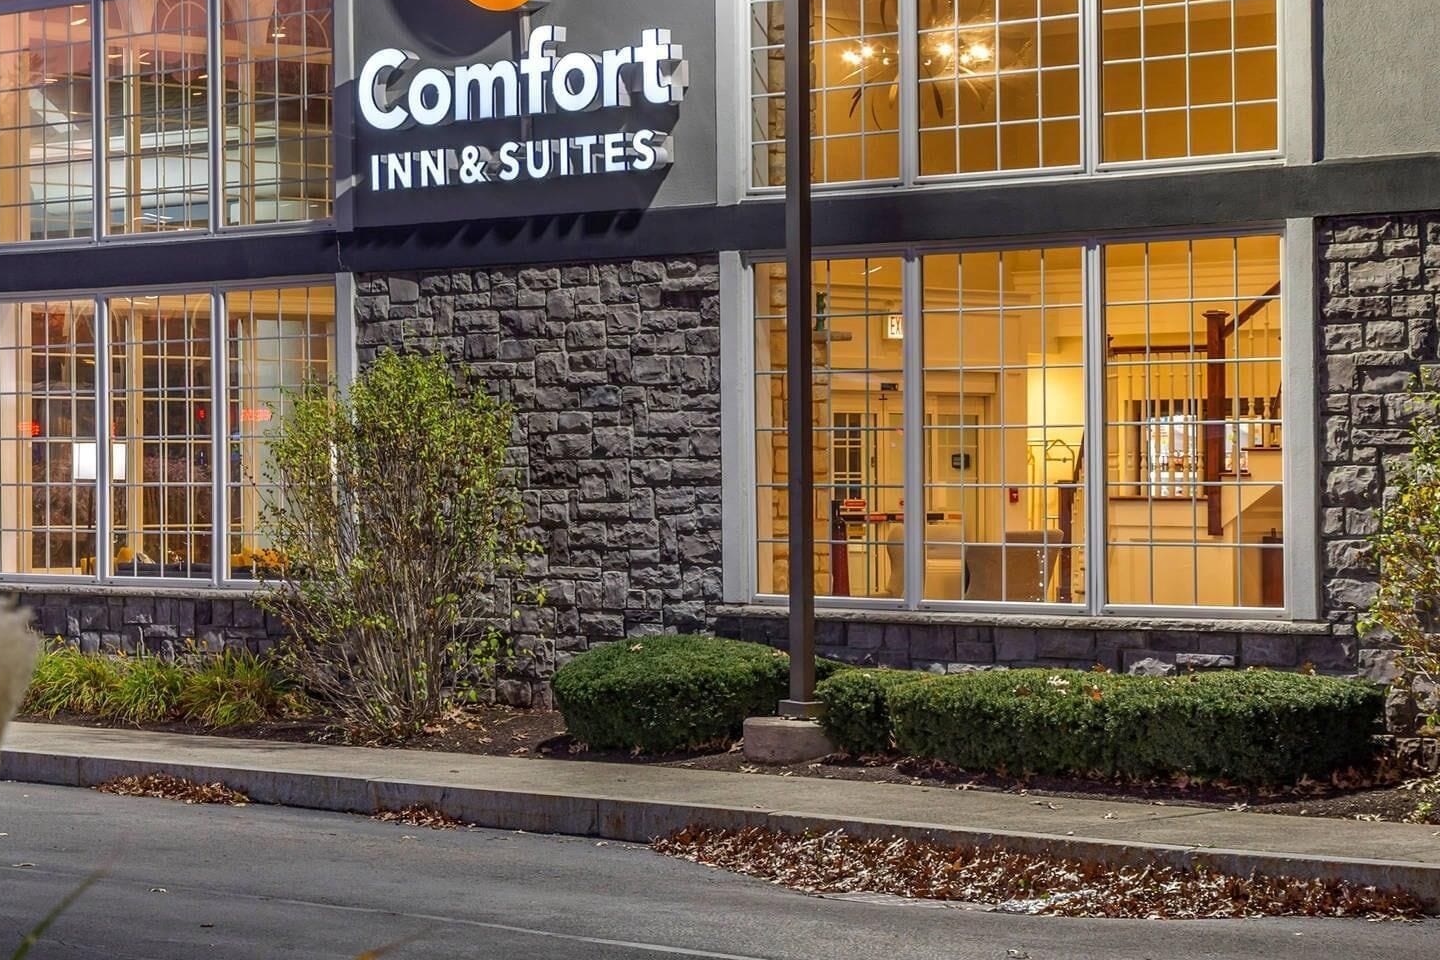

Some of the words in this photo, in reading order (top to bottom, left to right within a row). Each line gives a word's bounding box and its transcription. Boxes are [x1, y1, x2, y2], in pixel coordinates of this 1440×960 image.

[359, 24, 673, 130] Comfort
[371, 149, 446, 192] INN
[459, 145, 487, 184] &
[498, 129, 657, 180] SUITES
